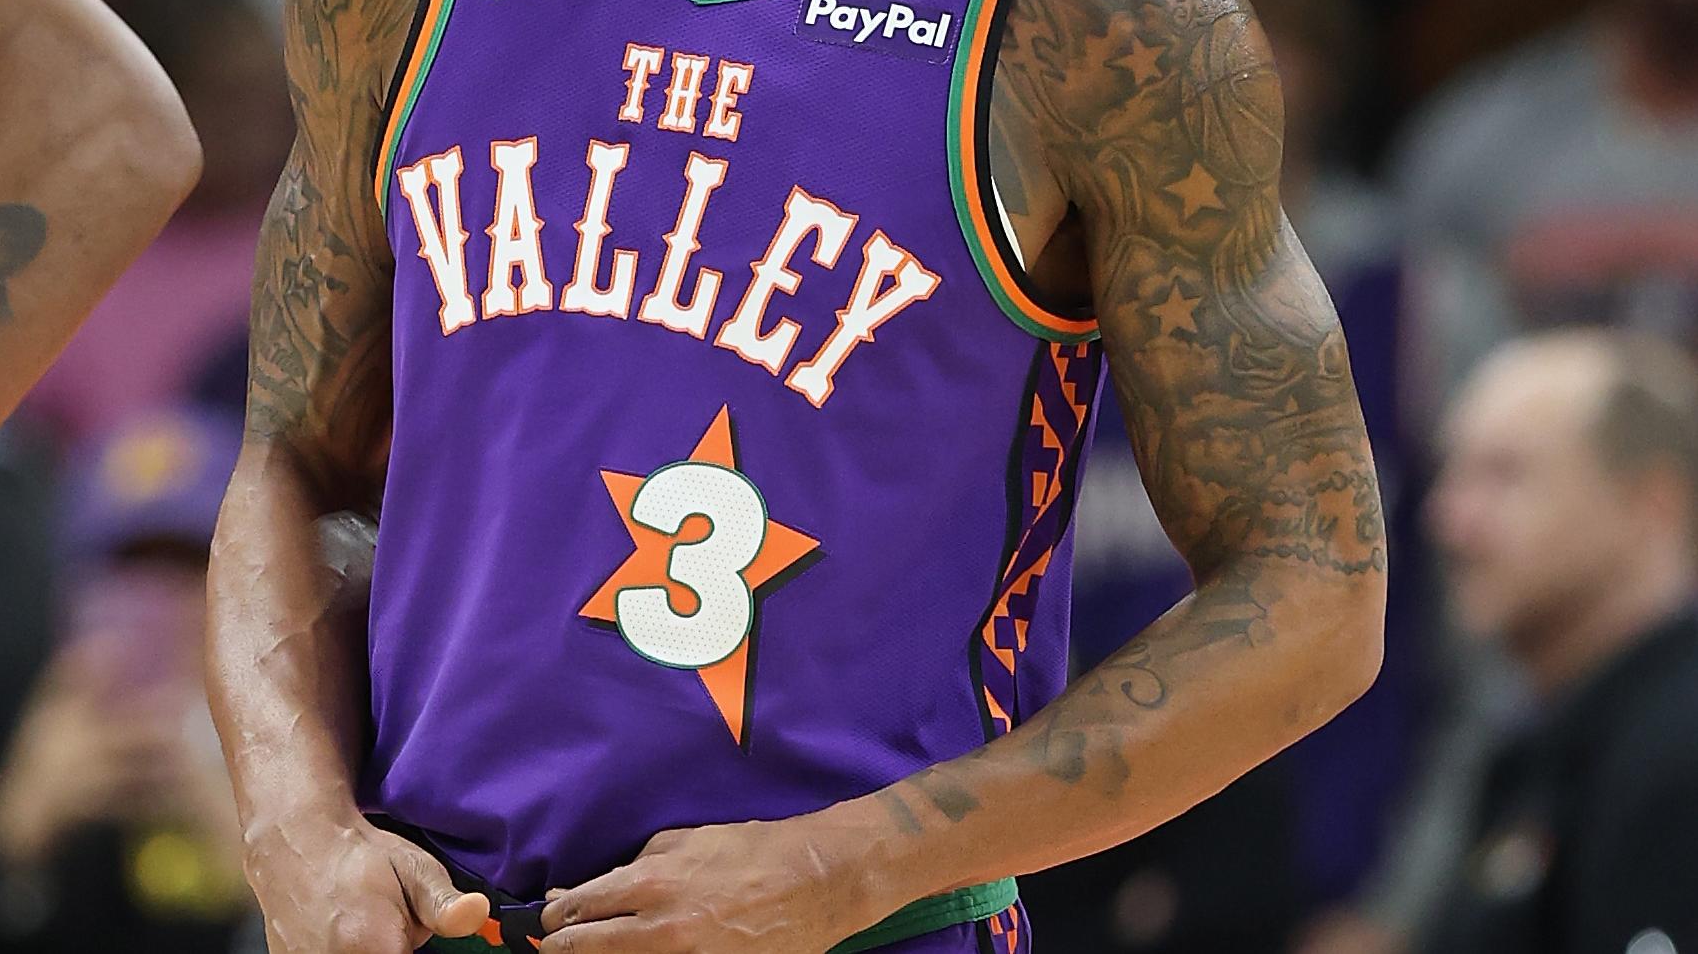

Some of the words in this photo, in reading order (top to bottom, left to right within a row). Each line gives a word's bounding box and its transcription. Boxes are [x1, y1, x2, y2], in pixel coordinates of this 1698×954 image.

[619, 43, 754, 141] THE
[396, 136, 942, 409] VALLEY
[614, 460, 767, 669] 3
